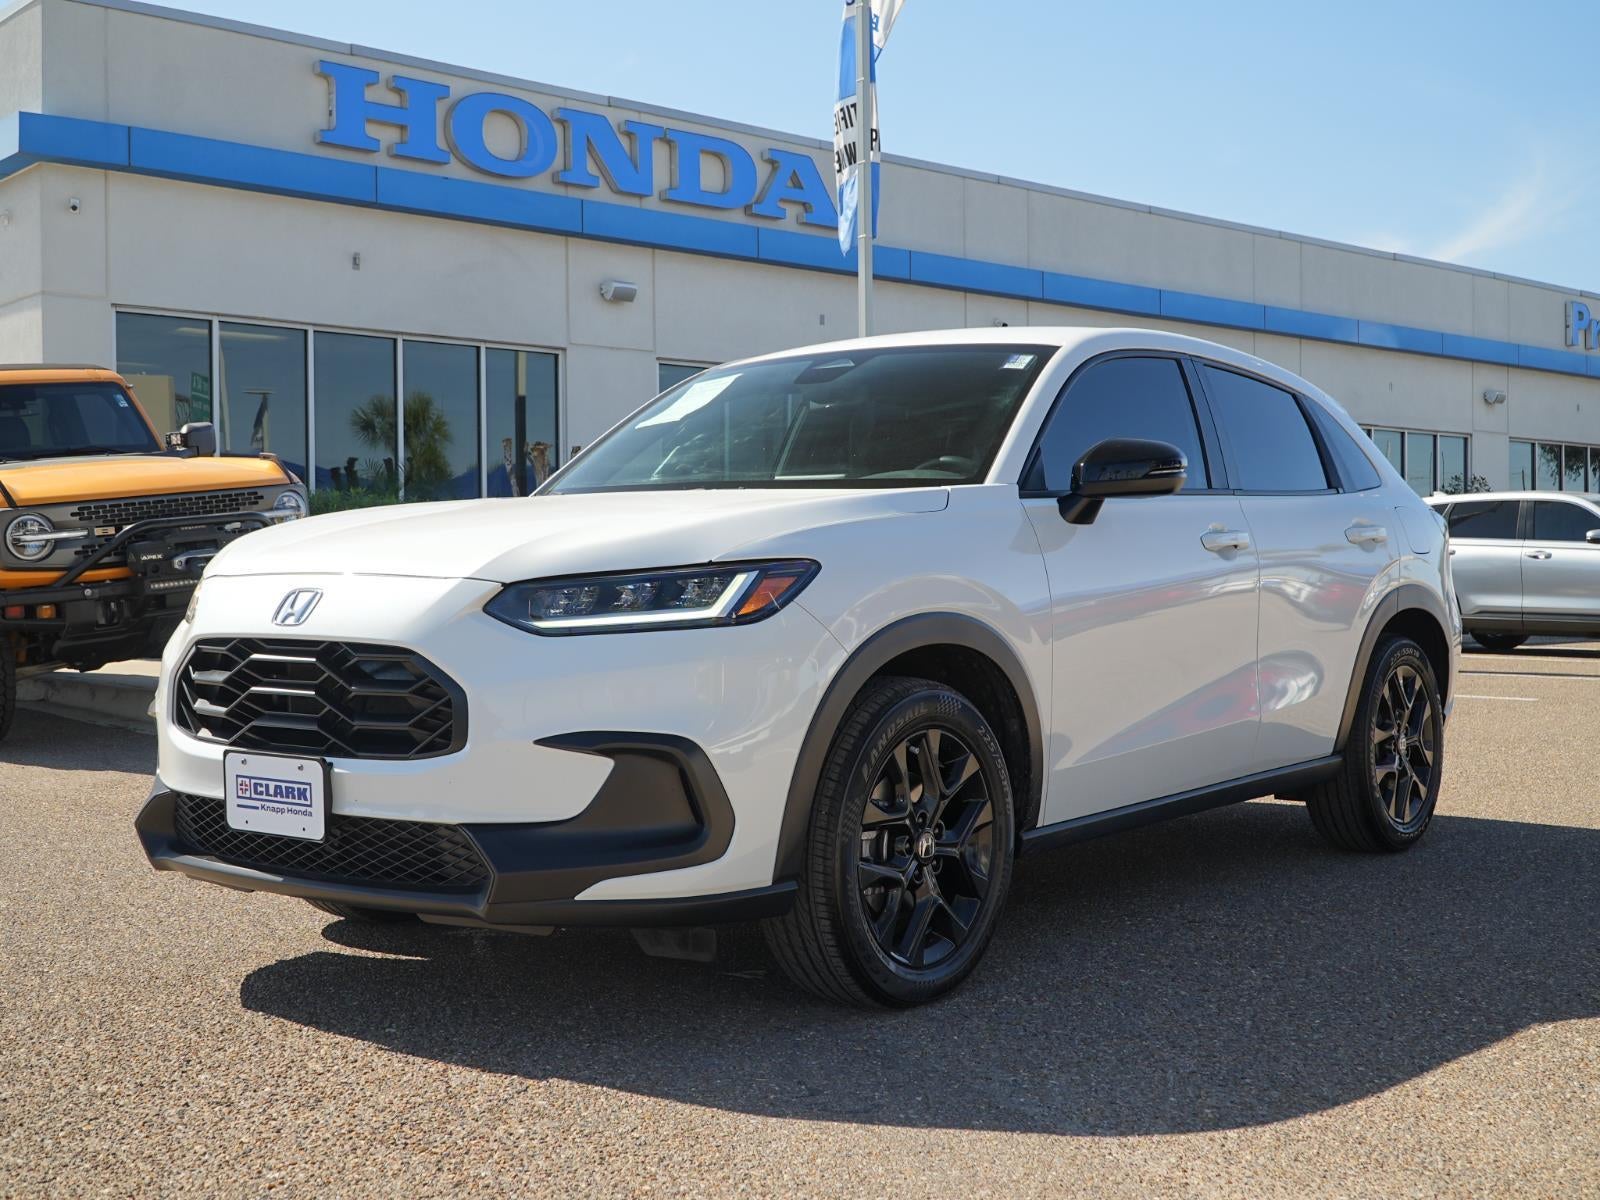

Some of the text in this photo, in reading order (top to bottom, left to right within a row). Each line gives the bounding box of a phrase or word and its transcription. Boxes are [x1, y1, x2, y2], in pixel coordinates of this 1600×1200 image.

[314, 60, 838, 229] HONDA
[252, 781, 309, 802] CLARK
[260, 803, 313, 817] Knapp Honda
